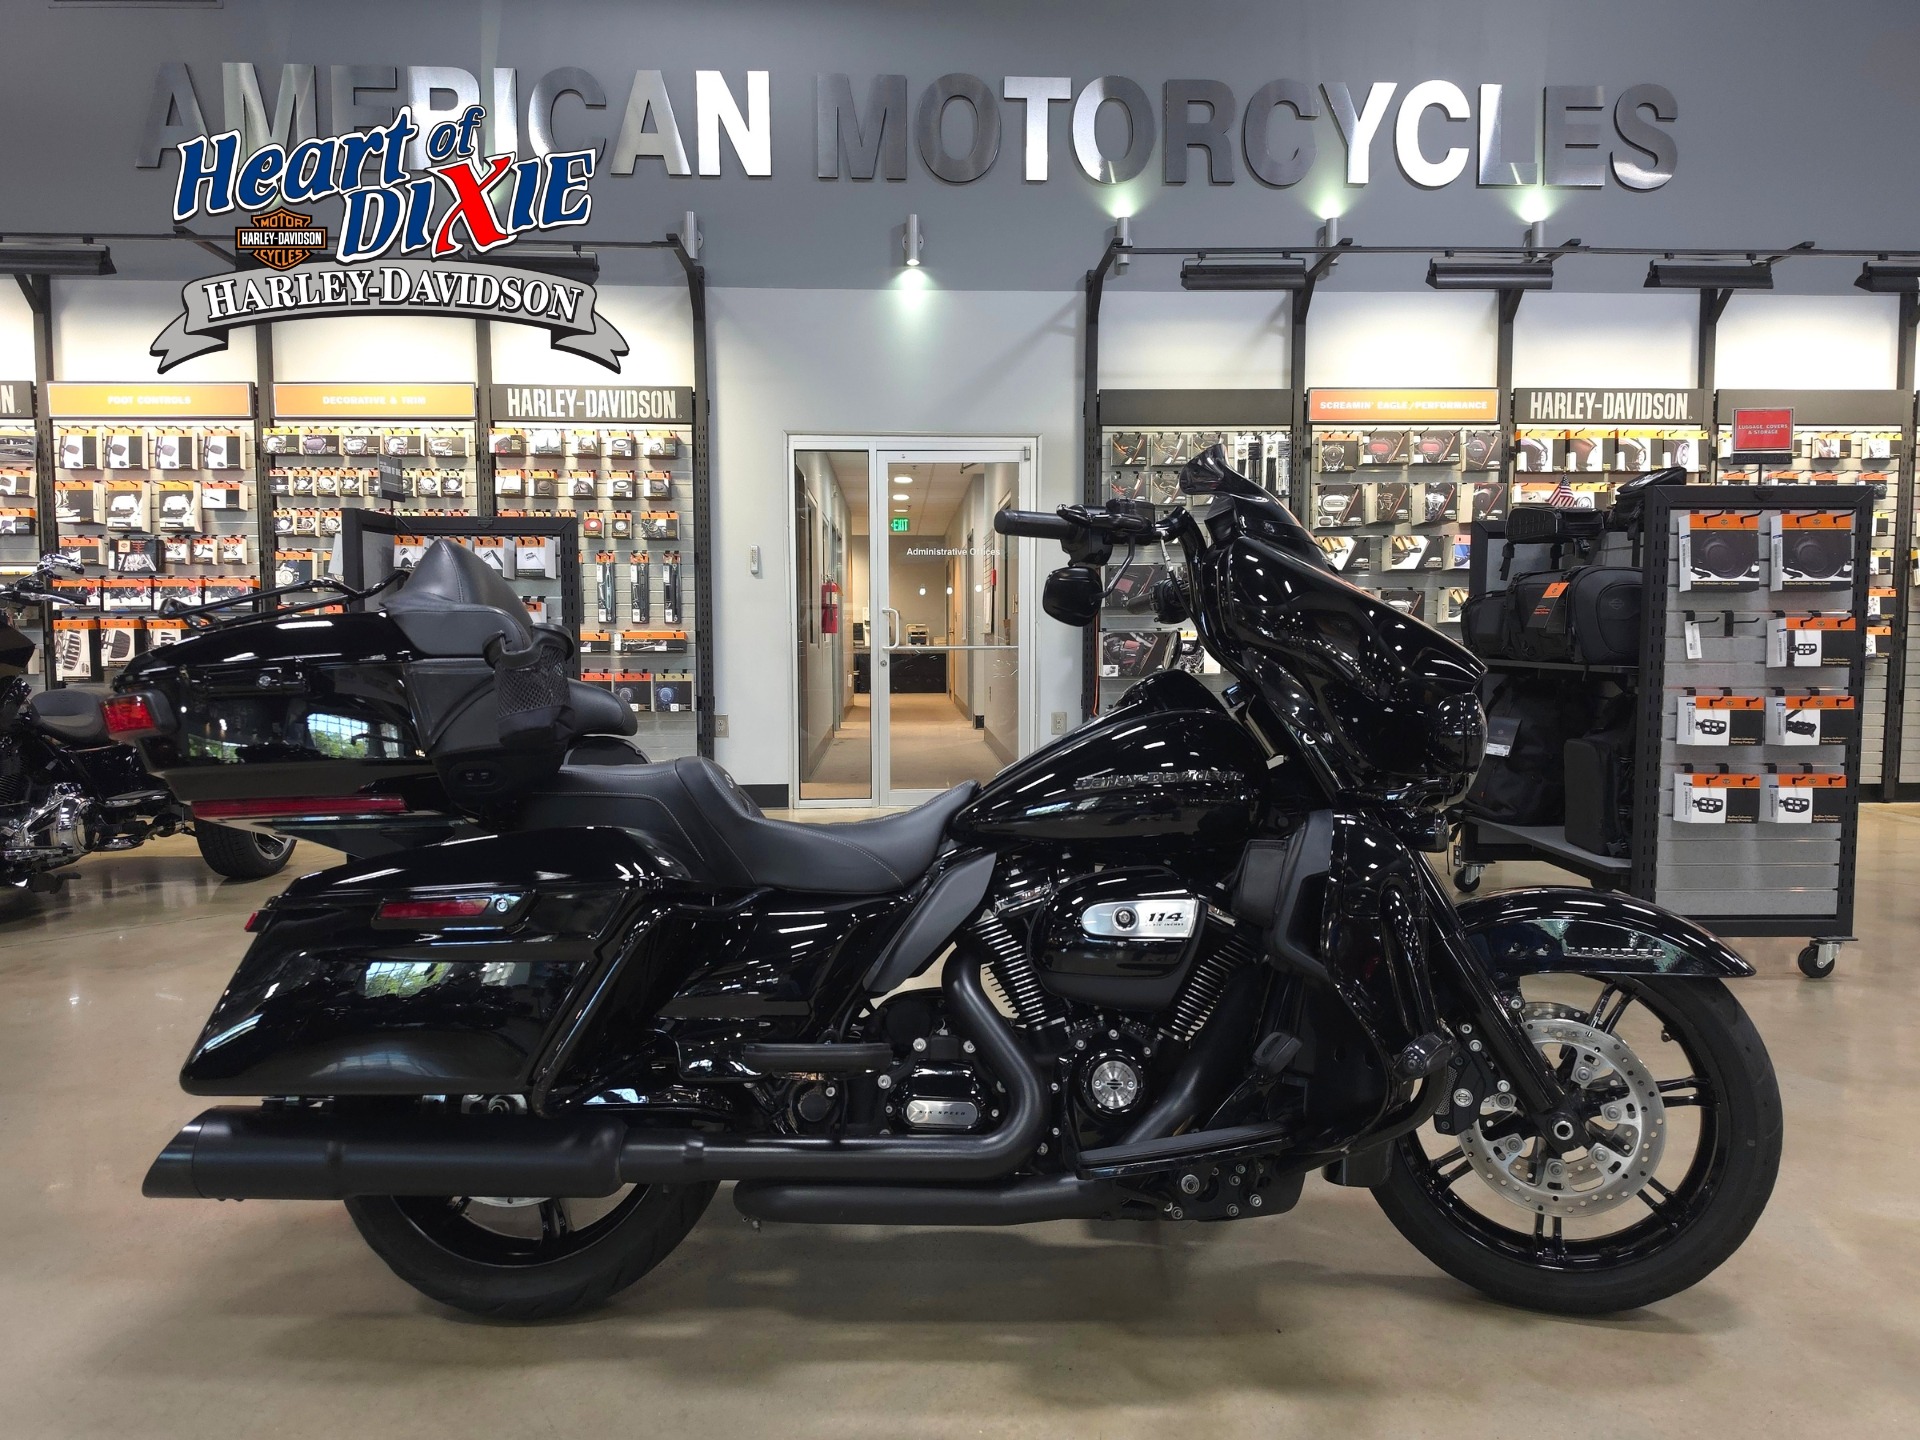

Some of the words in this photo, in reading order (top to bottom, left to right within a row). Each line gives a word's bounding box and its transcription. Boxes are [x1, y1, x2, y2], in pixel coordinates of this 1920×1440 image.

[135, 62, 773, 177] AMERICAN
[816, 72, 1679, 191] MOTORCYCLES
[107, 396, 133, 404] FOOT
[323, 396, 386, 405] DECORATIVE
[507, 388, 677, 418] HARLEY-DAVIDSON
[1320, 401, 1374, 410] SCREAMIN'
[1530, 391, 1689, 420] HARLEY-DAVIDSON
[893, 519, 909, 531] EXIT
[906, 547, 968, 556] Administrative
[1149, 912, 1184, 922] 114
